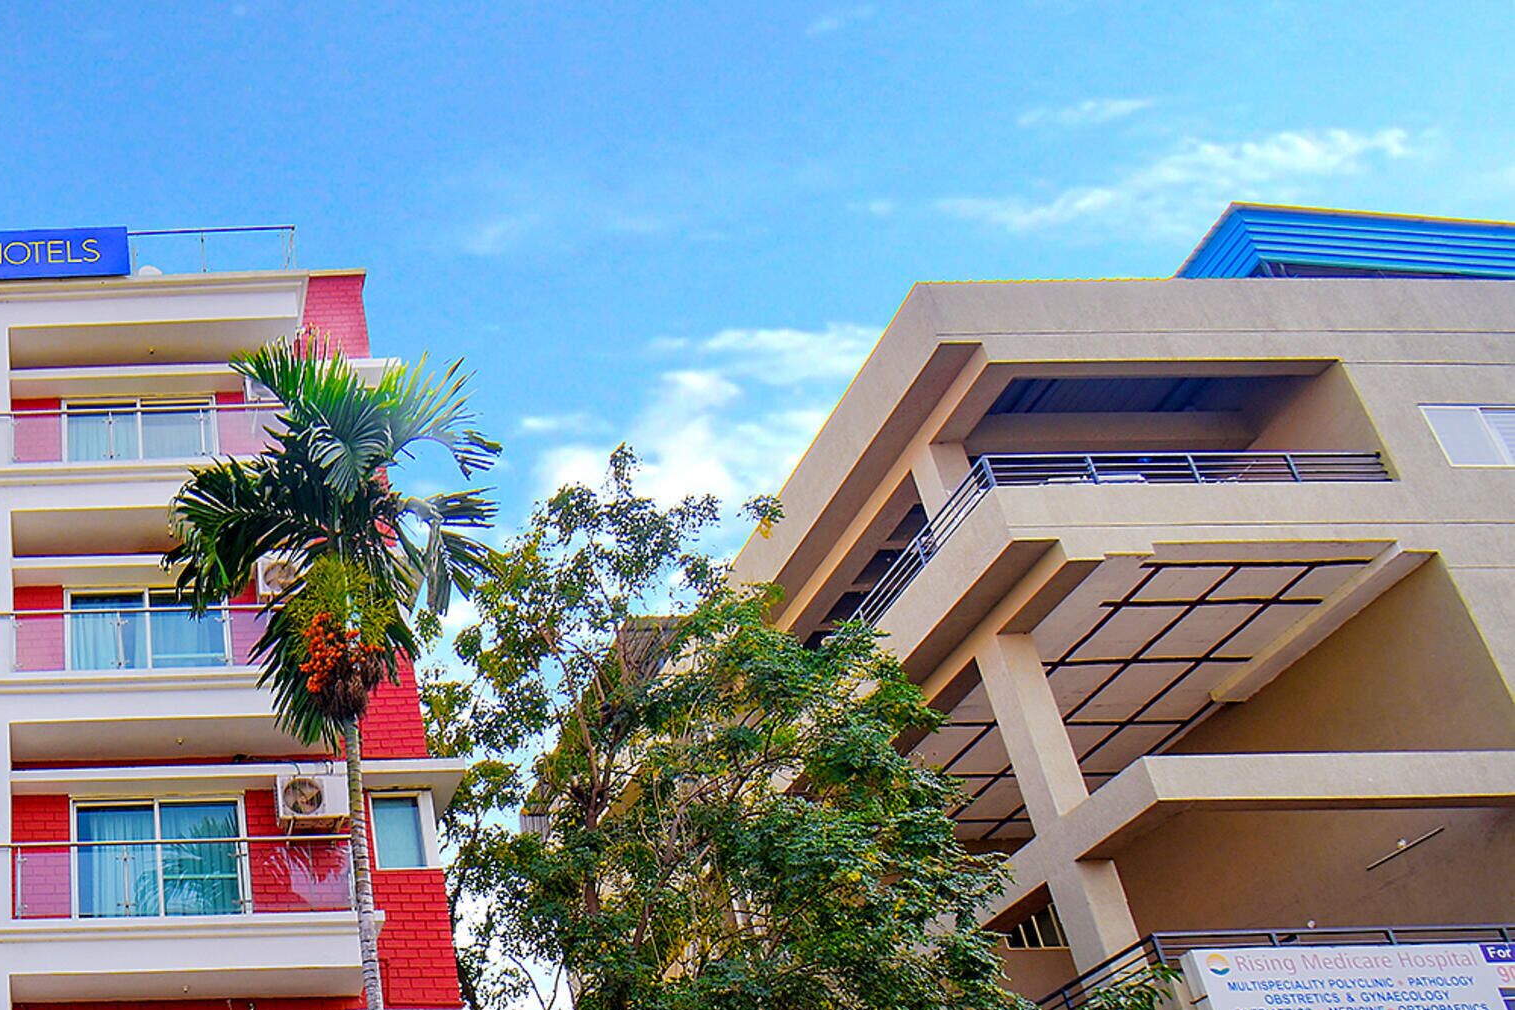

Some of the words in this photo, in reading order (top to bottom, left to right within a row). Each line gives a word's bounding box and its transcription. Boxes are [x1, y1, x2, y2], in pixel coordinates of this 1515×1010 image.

[1487, 946, 1512, 959] For
[1234, 954, 1297, 975] Rising
[1301, 952, 1393, 970] Medicare
[1397, 949, 1478, 972] Hospital
[1227, 979, 1326, 992] MULTISPECIALITY
[1328, 976, 1394, 989] POLYCLINIC
[1407, 975, 1474, 987] PATHOLOGY
[1264, 992, 1341, 1005] OBSTRETICS
[1346, 992, 1355, 1003] &
[1360, 989, 1450, 1003] GYNAECOLOGY
